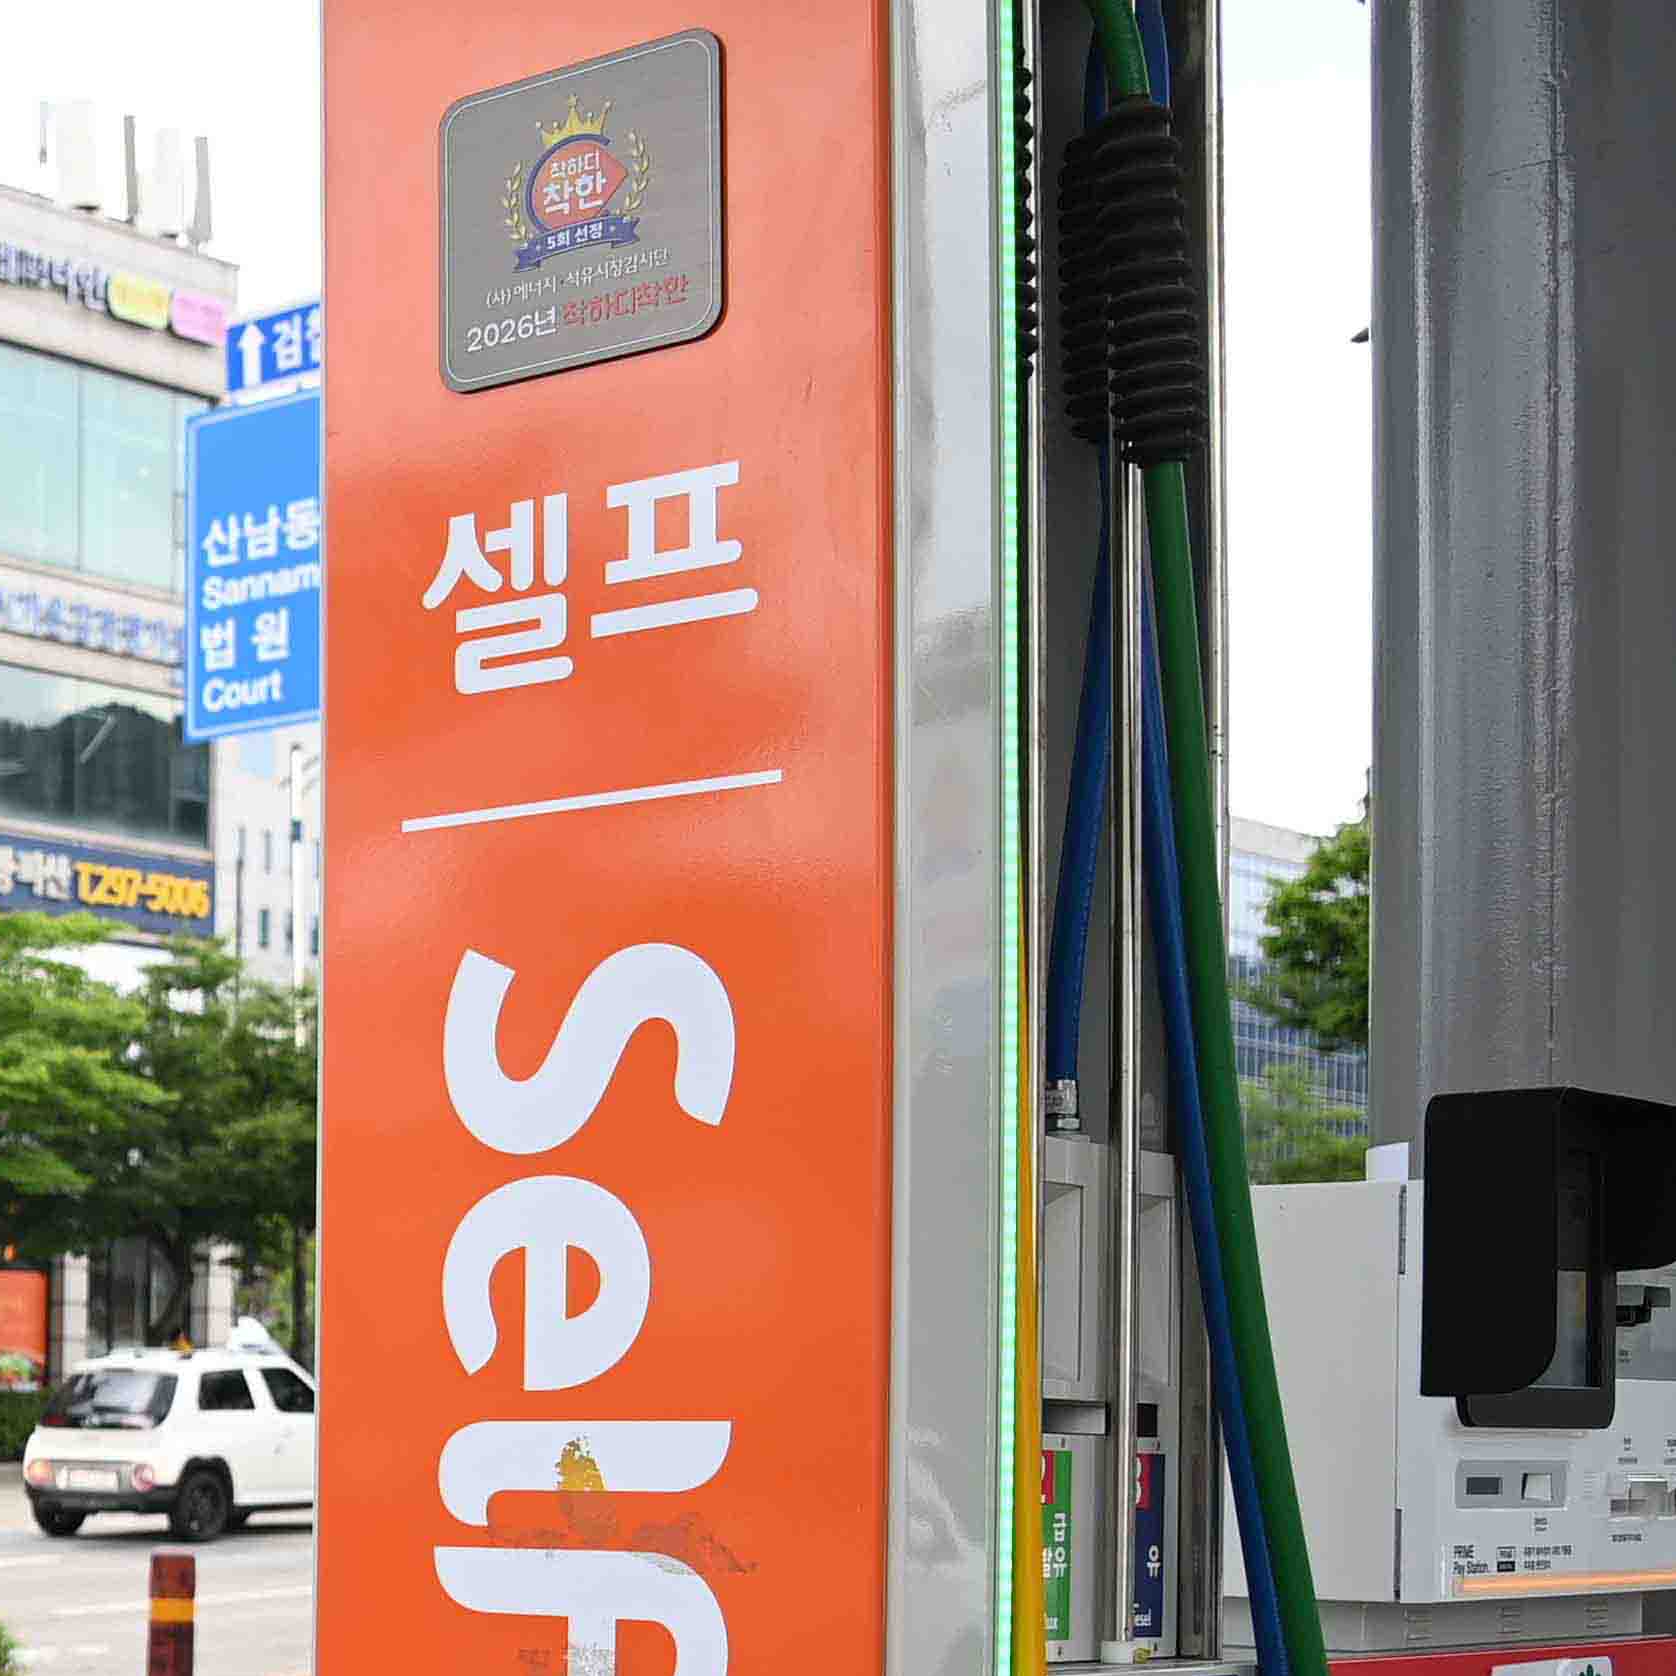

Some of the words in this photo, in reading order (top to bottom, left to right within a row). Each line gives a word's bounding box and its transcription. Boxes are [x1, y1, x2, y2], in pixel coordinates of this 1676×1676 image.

[543, 171, 607, 215] 착한
[465, 305, 557, 353] 2026년
[202, 498, 320, 567] 산남동
[421, 460, 760, 695] 셀프
[201, 669, 284, 712] Court
